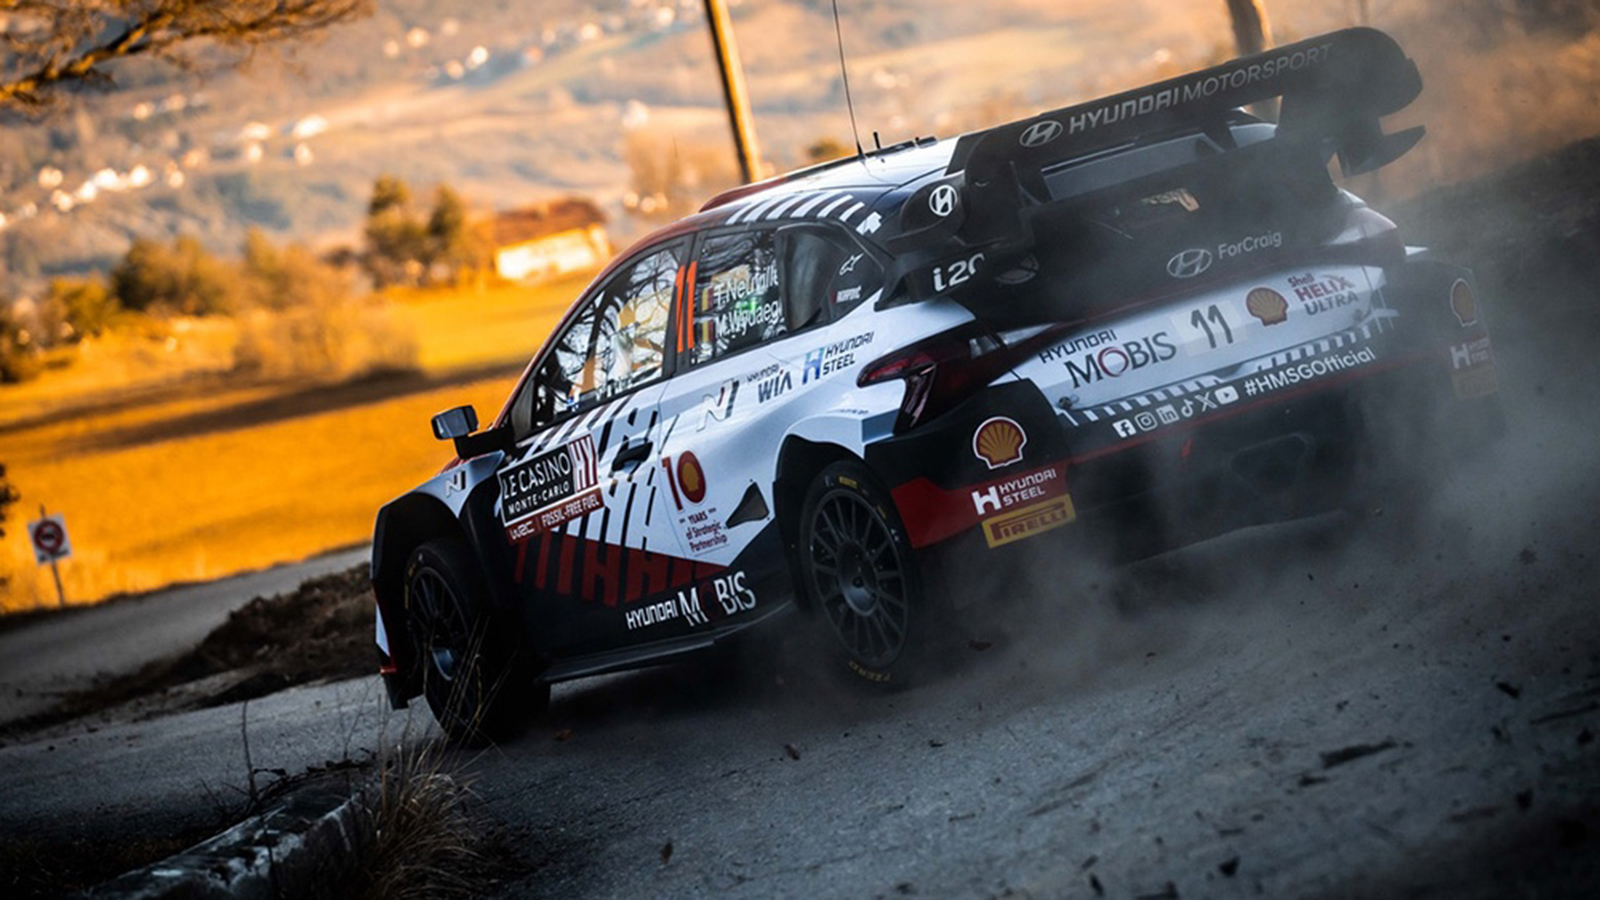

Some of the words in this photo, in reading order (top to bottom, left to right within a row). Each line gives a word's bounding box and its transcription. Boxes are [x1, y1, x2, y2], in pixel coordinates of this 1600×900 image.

[1069, 88, 1179, 134] HYUNDAI
[1183, 43, 1332, 102] MOTORSPORT
[1218, 230, 1282, 260] ForCraig
[1287, 273, 1315, 288] Shell
[1294, 276, 1346, 302] HELIX
[674, 260, 698, 353] 11
[1304, 290, 1359, 316] ULTRA
[1191, 304, 1234, 349] 11
[825, 331, 874, 359] HYUNDAI
[1039, 329, 1117, 364] HYUNDAI
[1063, 331, 1177, 389] MOBIS
[823, 353, 855, 375] STEEL
[1244, 347, 1376, 398] #HMSGOfficial
[758, 369, 792, 403] WIA
[502, 474, 518, 500] LE
[518, 452, 571, 492] CASINO
[570, 435, 596, 492] HY
[999, 468, 1056, 494] HYUNDAI
[1002, 486, 1045, 506] STEEL
[509, 521, 535, 540] WRC
[582, 494, 600, 512] FUEL
[687, 510, 708, 525] YEARS
[990, 502, 1068, 540] PIRELLI
[689, 534, 728, 552] Partnership
[625, 599, 679, 629] HYUNDAI
